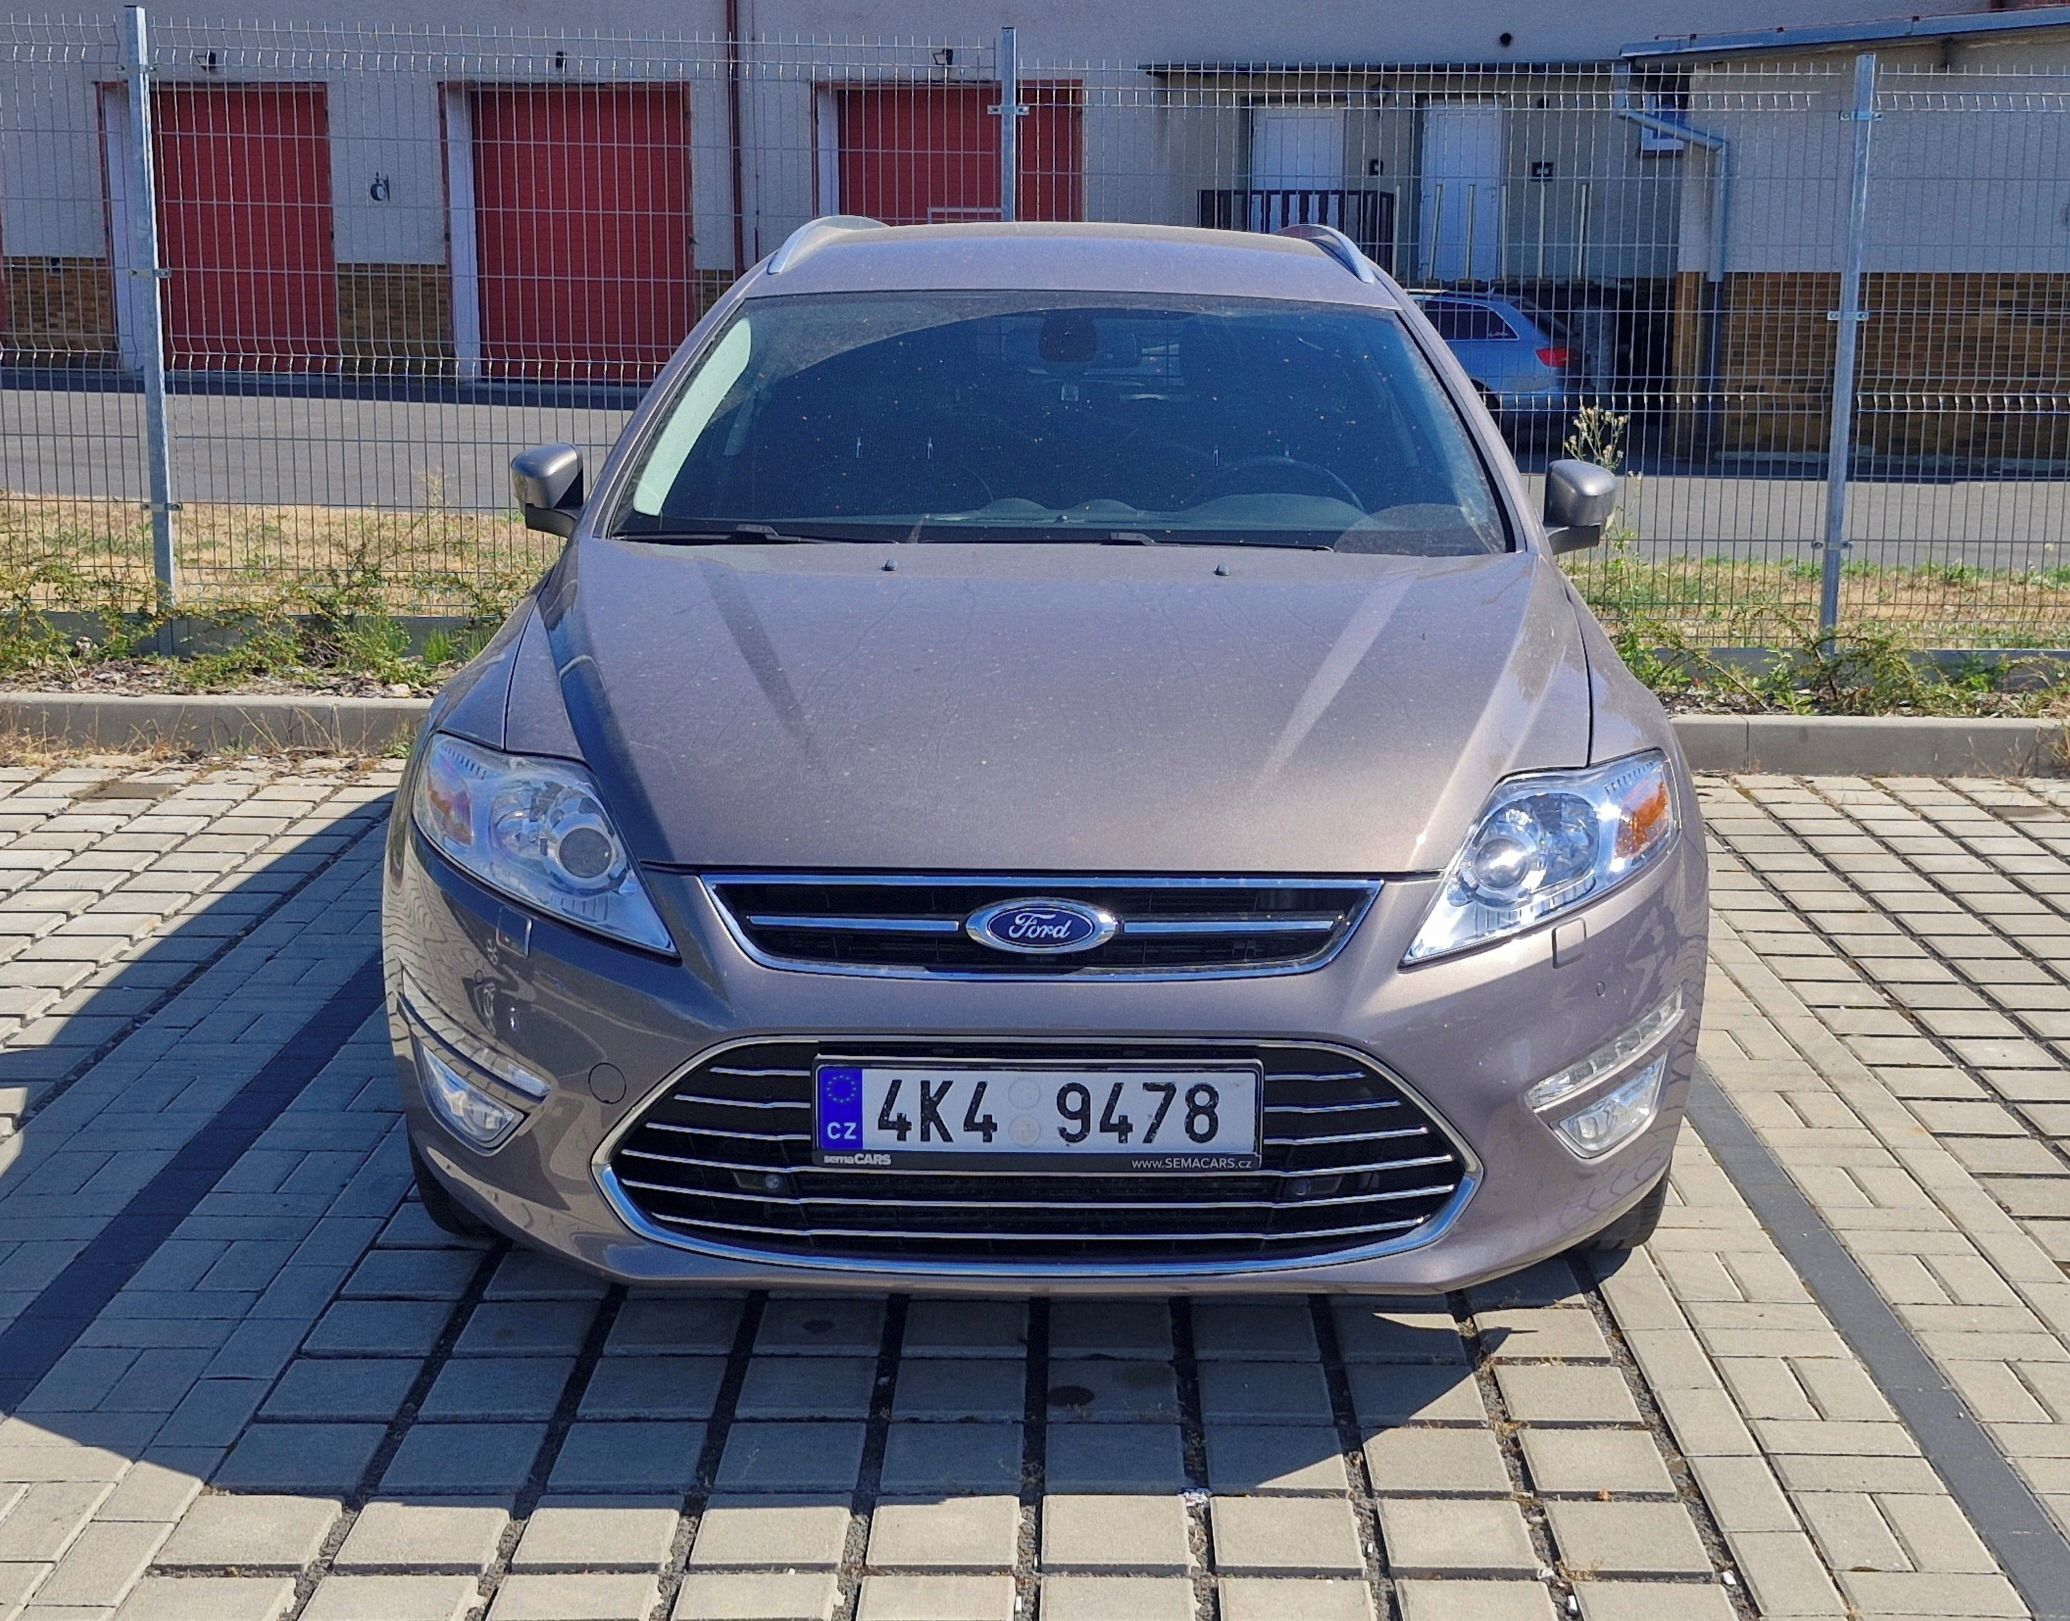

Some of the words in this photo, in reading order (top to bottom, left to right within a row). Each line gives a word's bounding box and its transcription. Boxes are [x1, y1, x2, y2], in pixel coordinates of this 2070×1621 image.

[1008, 912, 1072, 938] Ford
[878, 1079, 998, 1142] 4K4
[1056, 1082, 1220, 1144] 9478
[827, 1122, 857, 1140] CZ
[824, 1153, 892, 1166] semaCARS
[1131, 1157, 1252, 1169] www.SEMACARS.cz
